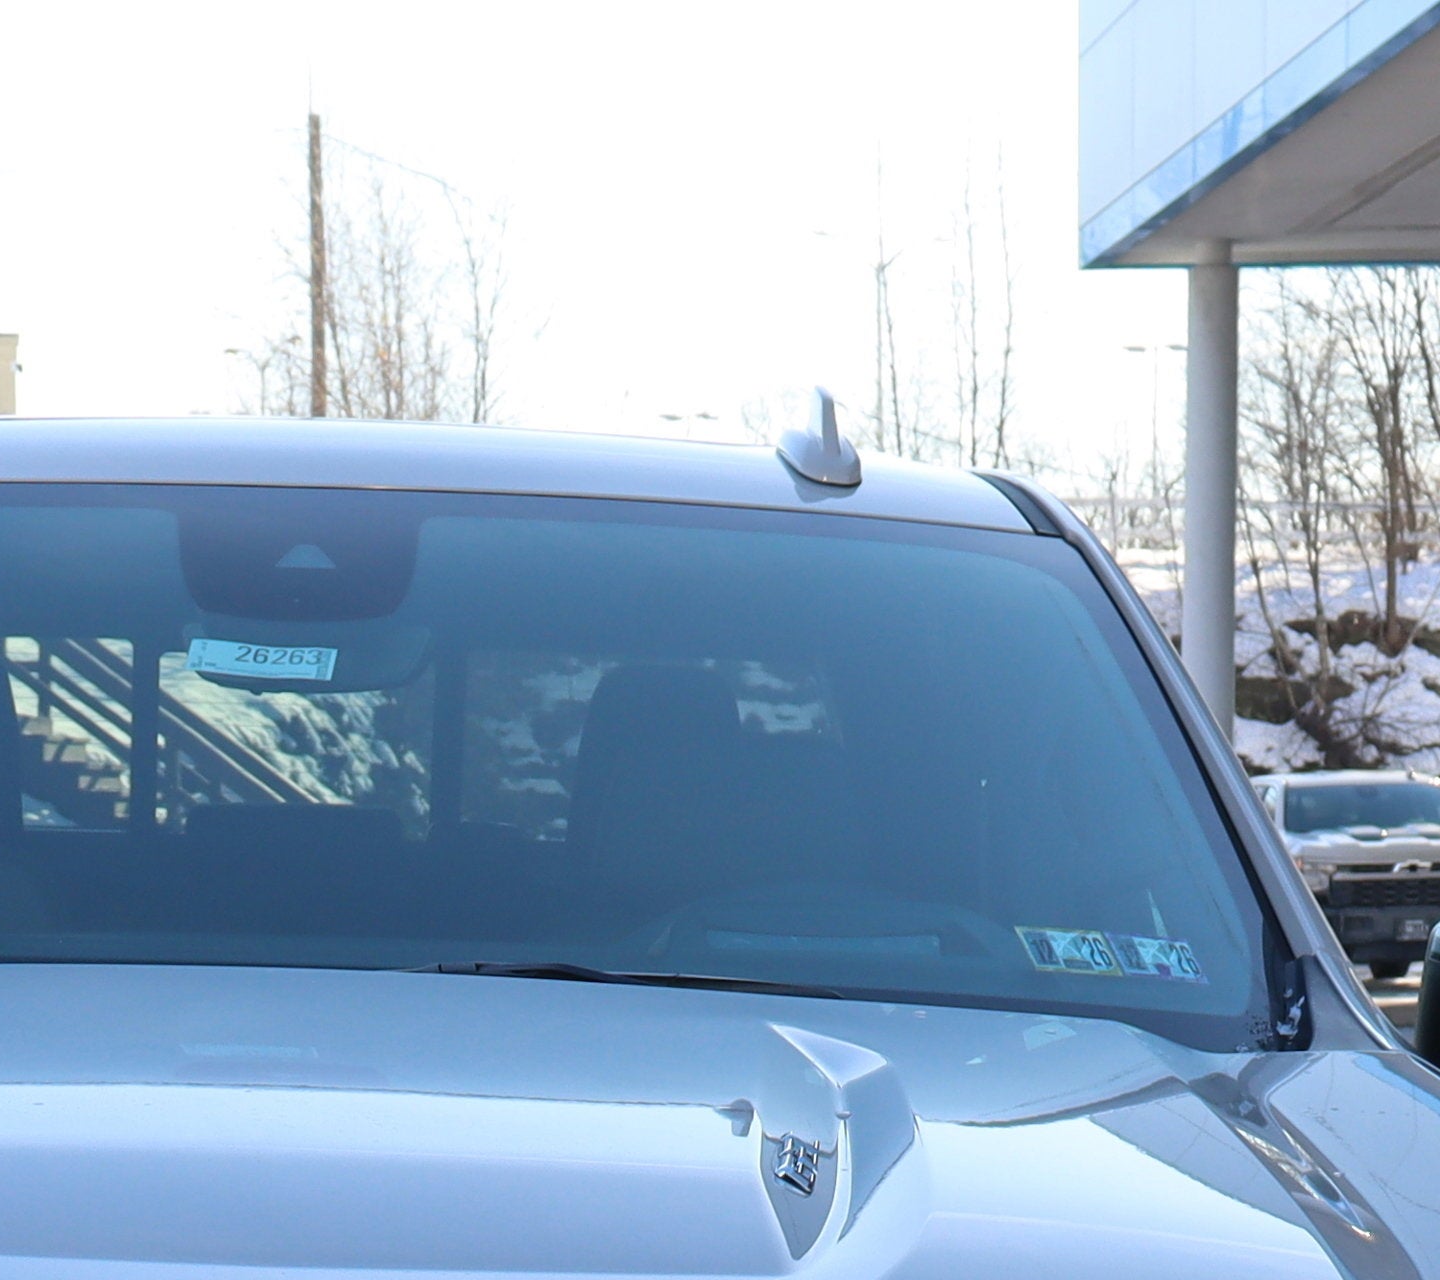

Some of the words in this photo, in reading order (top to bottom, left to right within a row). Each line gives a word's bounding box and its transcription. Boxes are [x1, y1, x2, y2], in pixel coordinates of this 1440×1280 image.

[234, 645, 321, 666] 26263
[1031, 938, 1058, 965] 12
[1081, 935, 1114, 967] 26
[1169, 943, 1202, 975] 26
